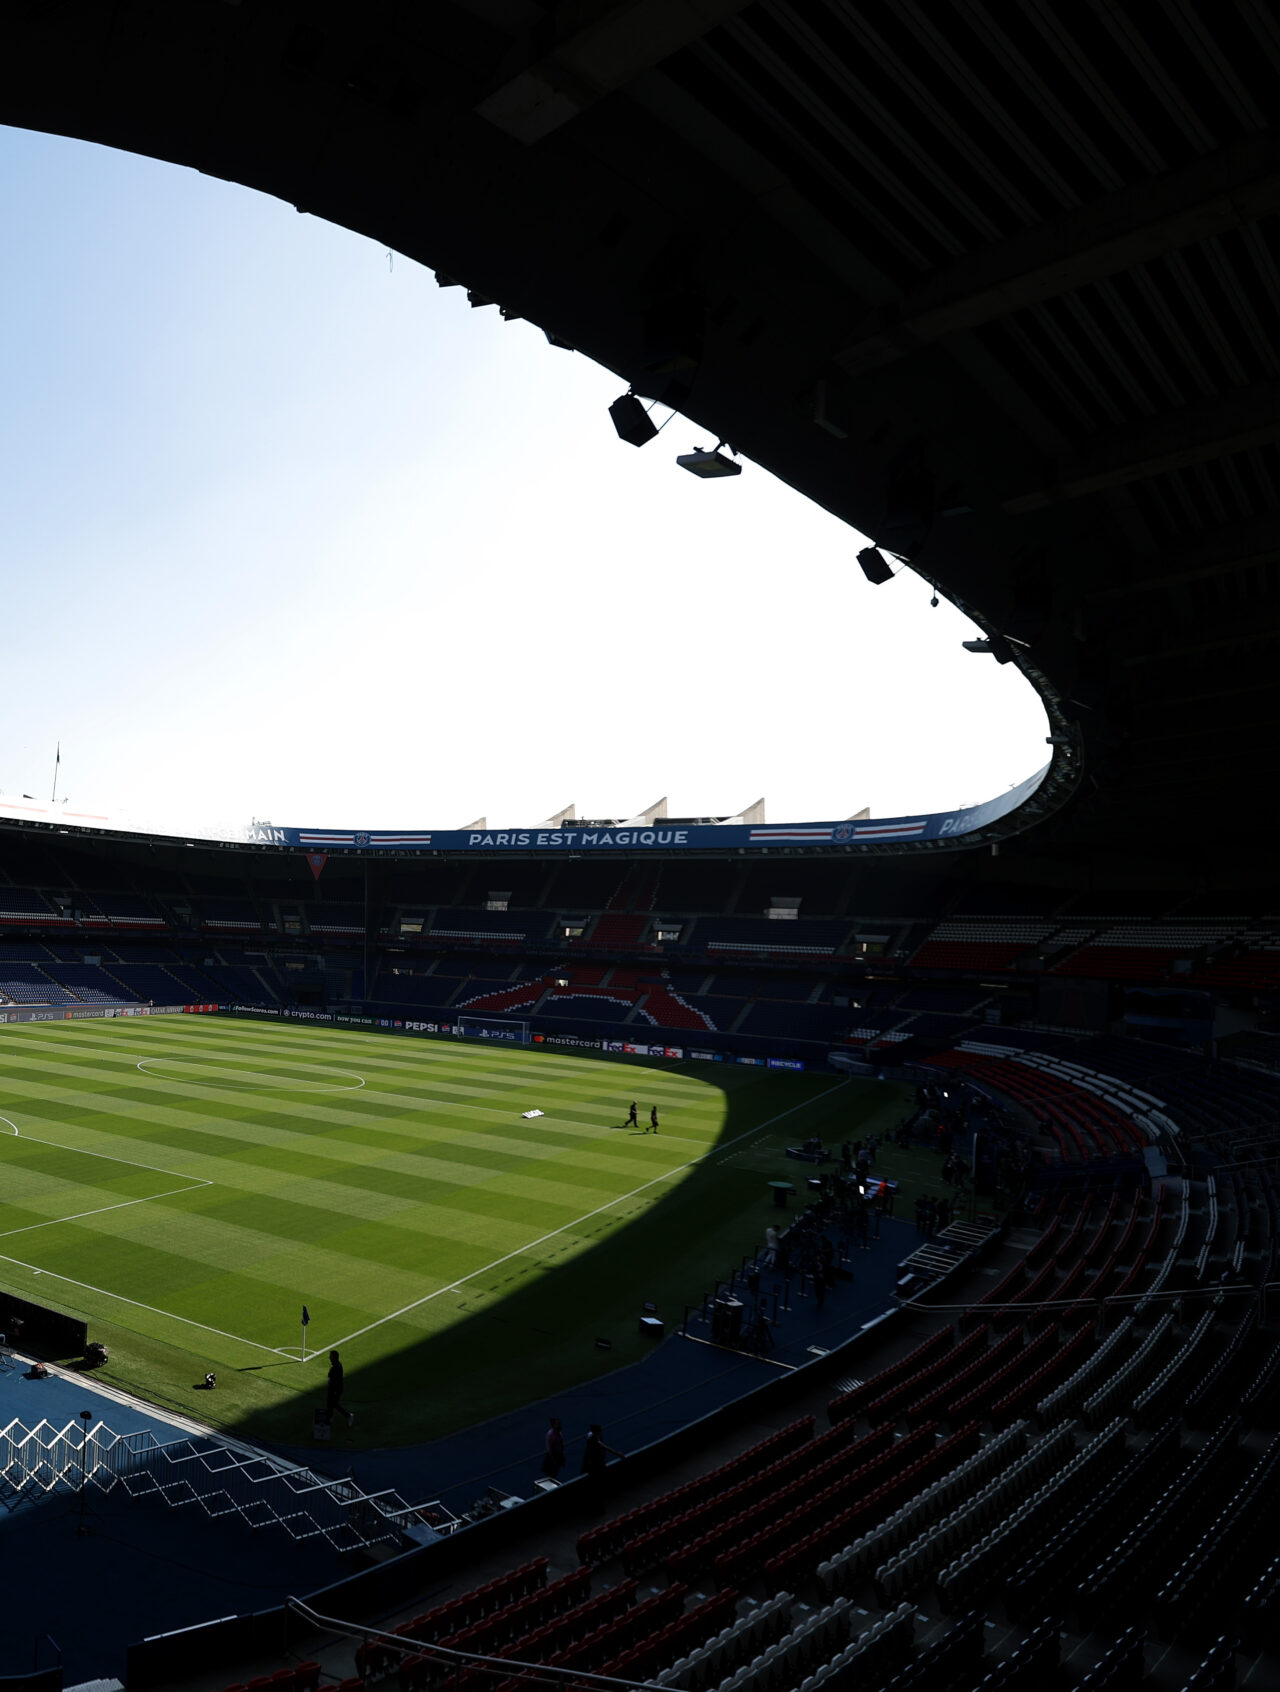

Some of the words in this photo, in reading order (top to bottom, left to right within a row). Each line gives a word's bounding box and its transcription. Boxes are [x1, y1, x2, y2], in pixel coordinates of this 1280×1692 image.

[469, 833, 530, 846] PARIS
[536, 833, 577, 845] EST
[581, 831, 689, 846] MAGIQUE
[73, 1010, 104, 1018] mastercard
[291, 1010, 332, 1021] crypto.com
[405, 1021, 438, 1033] PEPSI
[491, 1030, 516, 1040] PS5
[546, 1036, 601, 1049] mastercard
